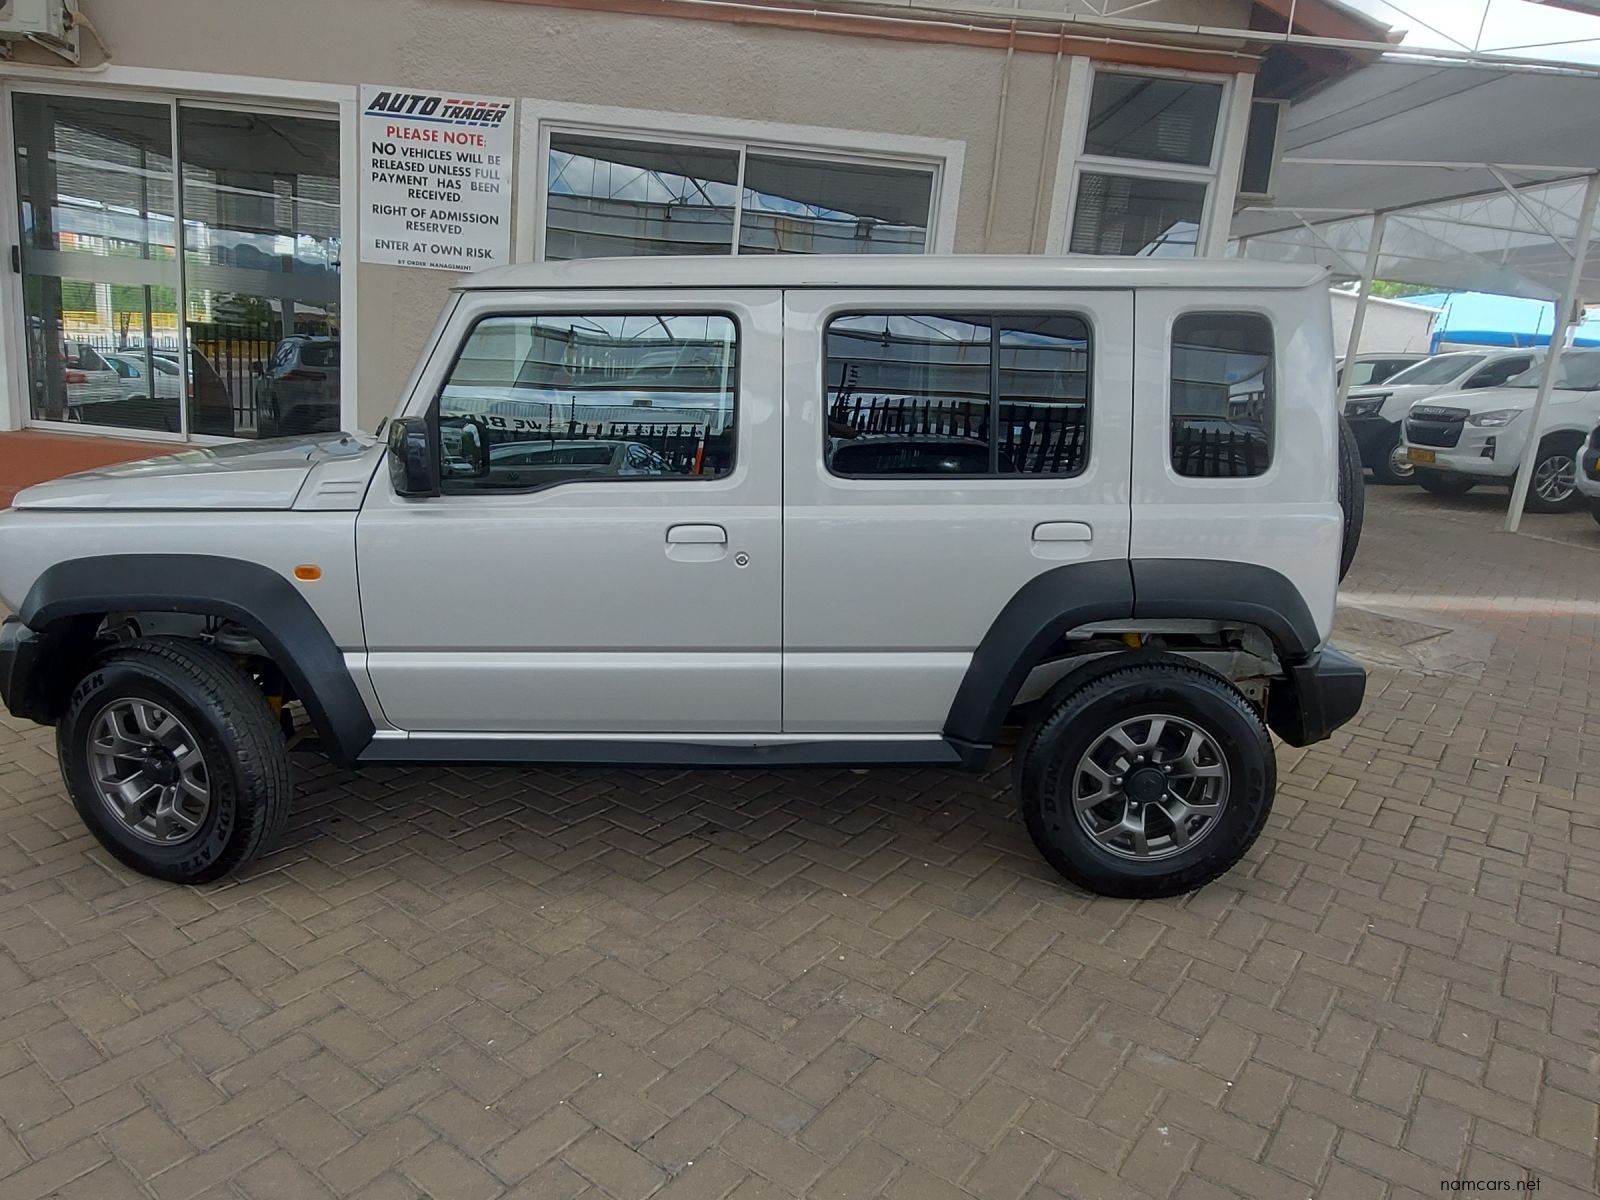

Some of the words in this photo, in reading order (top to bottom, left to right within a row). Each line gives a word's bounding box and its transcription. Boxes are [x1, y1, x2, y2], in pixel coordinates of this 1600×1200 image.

[368, 92, 442, 116] AUTO
[440, 105, 507, 123] TRADER
[386, 126, 438, 143] PLEASE
[443, 131, 487, 147] NOTE:
[372, 142, 396, 156] NO
[401, 147, 452, 161] VEHICLES
[456, 151, 484, 164] WILL
[487, 155, 501, 166] BE
[372, 158, 425, 172] RELEASED
[428, 164, 472, 177] UNLESS
[475, 168, 500, 180] FULL
[372, 172, 428, 187] PAYMENT
[437, 179, 462, 190] HAS
[470, 181, 500, 194] BEEN
[372, 204, 407, 217] RIGHT
[410, 207, 427, 219] OF
[429, 209, 499, 225] ADMISSION
[375, 239, 409, 252] ENTER
[412, 242, 428, 253] AT
[430, 244, 462, 257] OWN
[429, 262, 472, 271] MANAGEMENT
